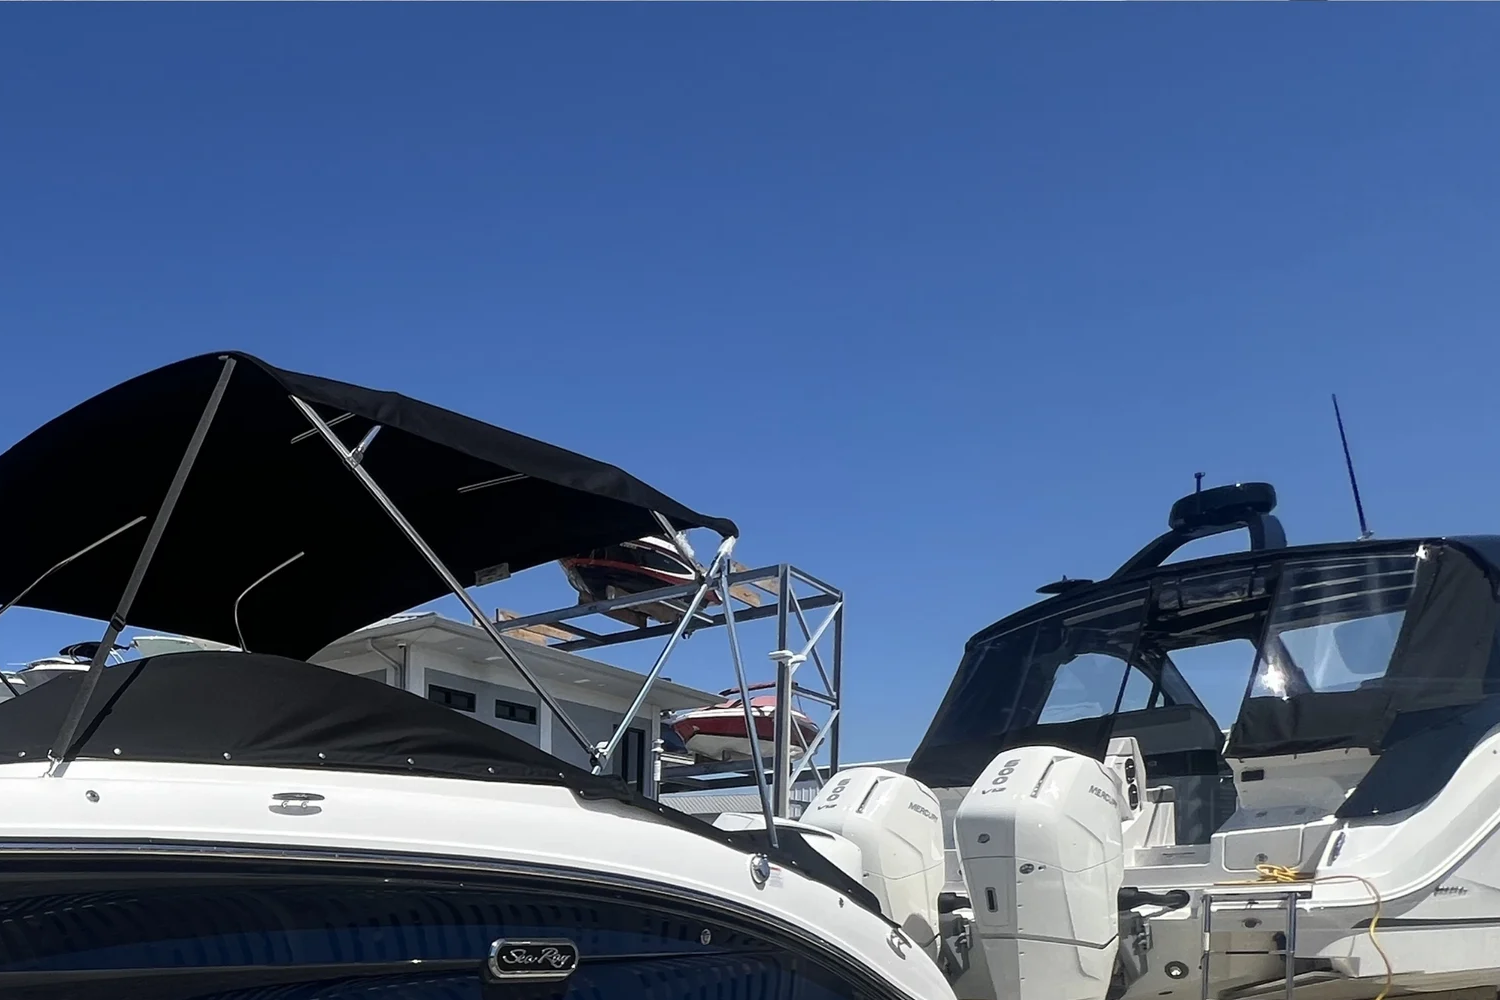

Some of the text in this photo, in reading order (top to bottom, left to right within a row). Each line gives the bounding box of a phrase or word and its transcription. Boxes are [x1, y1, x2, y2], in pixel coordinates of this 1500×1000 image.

[992, 758, 1021, 786] 500
[502, 947, 571, 969] Sea Ray
